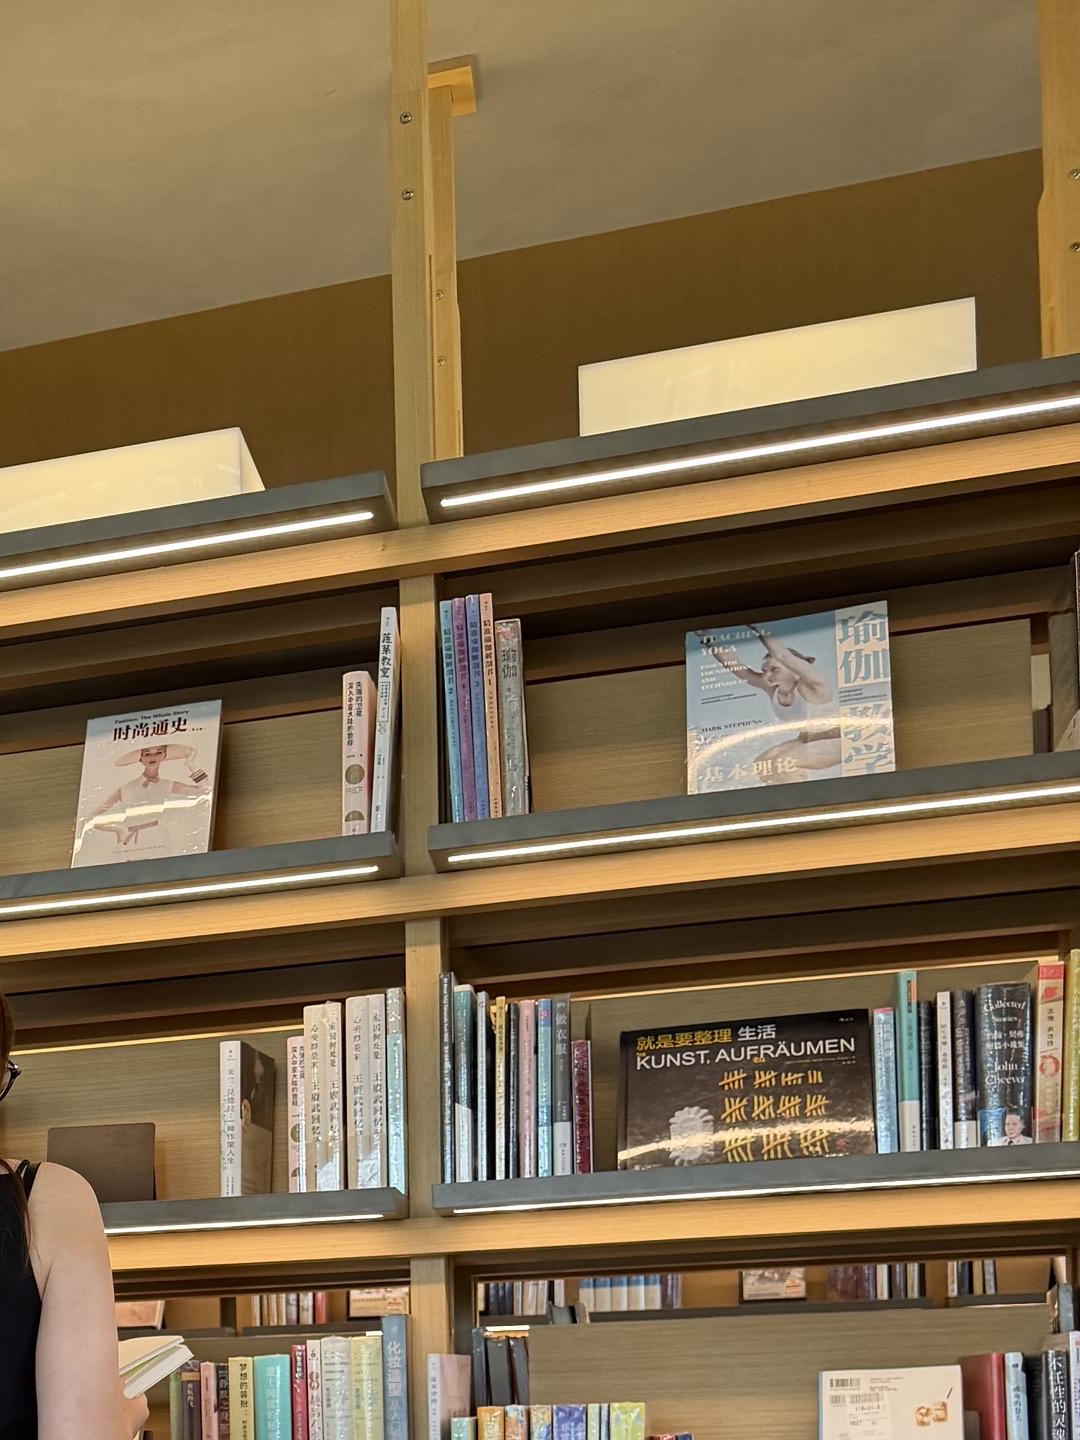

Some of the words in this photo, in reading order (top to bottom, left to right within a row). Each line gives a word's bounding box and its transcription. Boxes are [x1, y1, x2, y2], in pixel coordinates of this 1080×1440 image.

[501, 648, 518, 680] 瑜伽
[113, 717, 188, 742] 时尚通史
[703, 757, 798, 783] 基本理论
[984, 1000, 1026, 1012] Collected
[636, 1028, 733, 1052] 就是要整理
[737, 1024, 777, 1043] 生活
[715, 1037, 856, 1063] AUFRÄUMEN
[994, 1060, 1019, 1072] John
[985, 1074, 1026, 1086] Cheever
